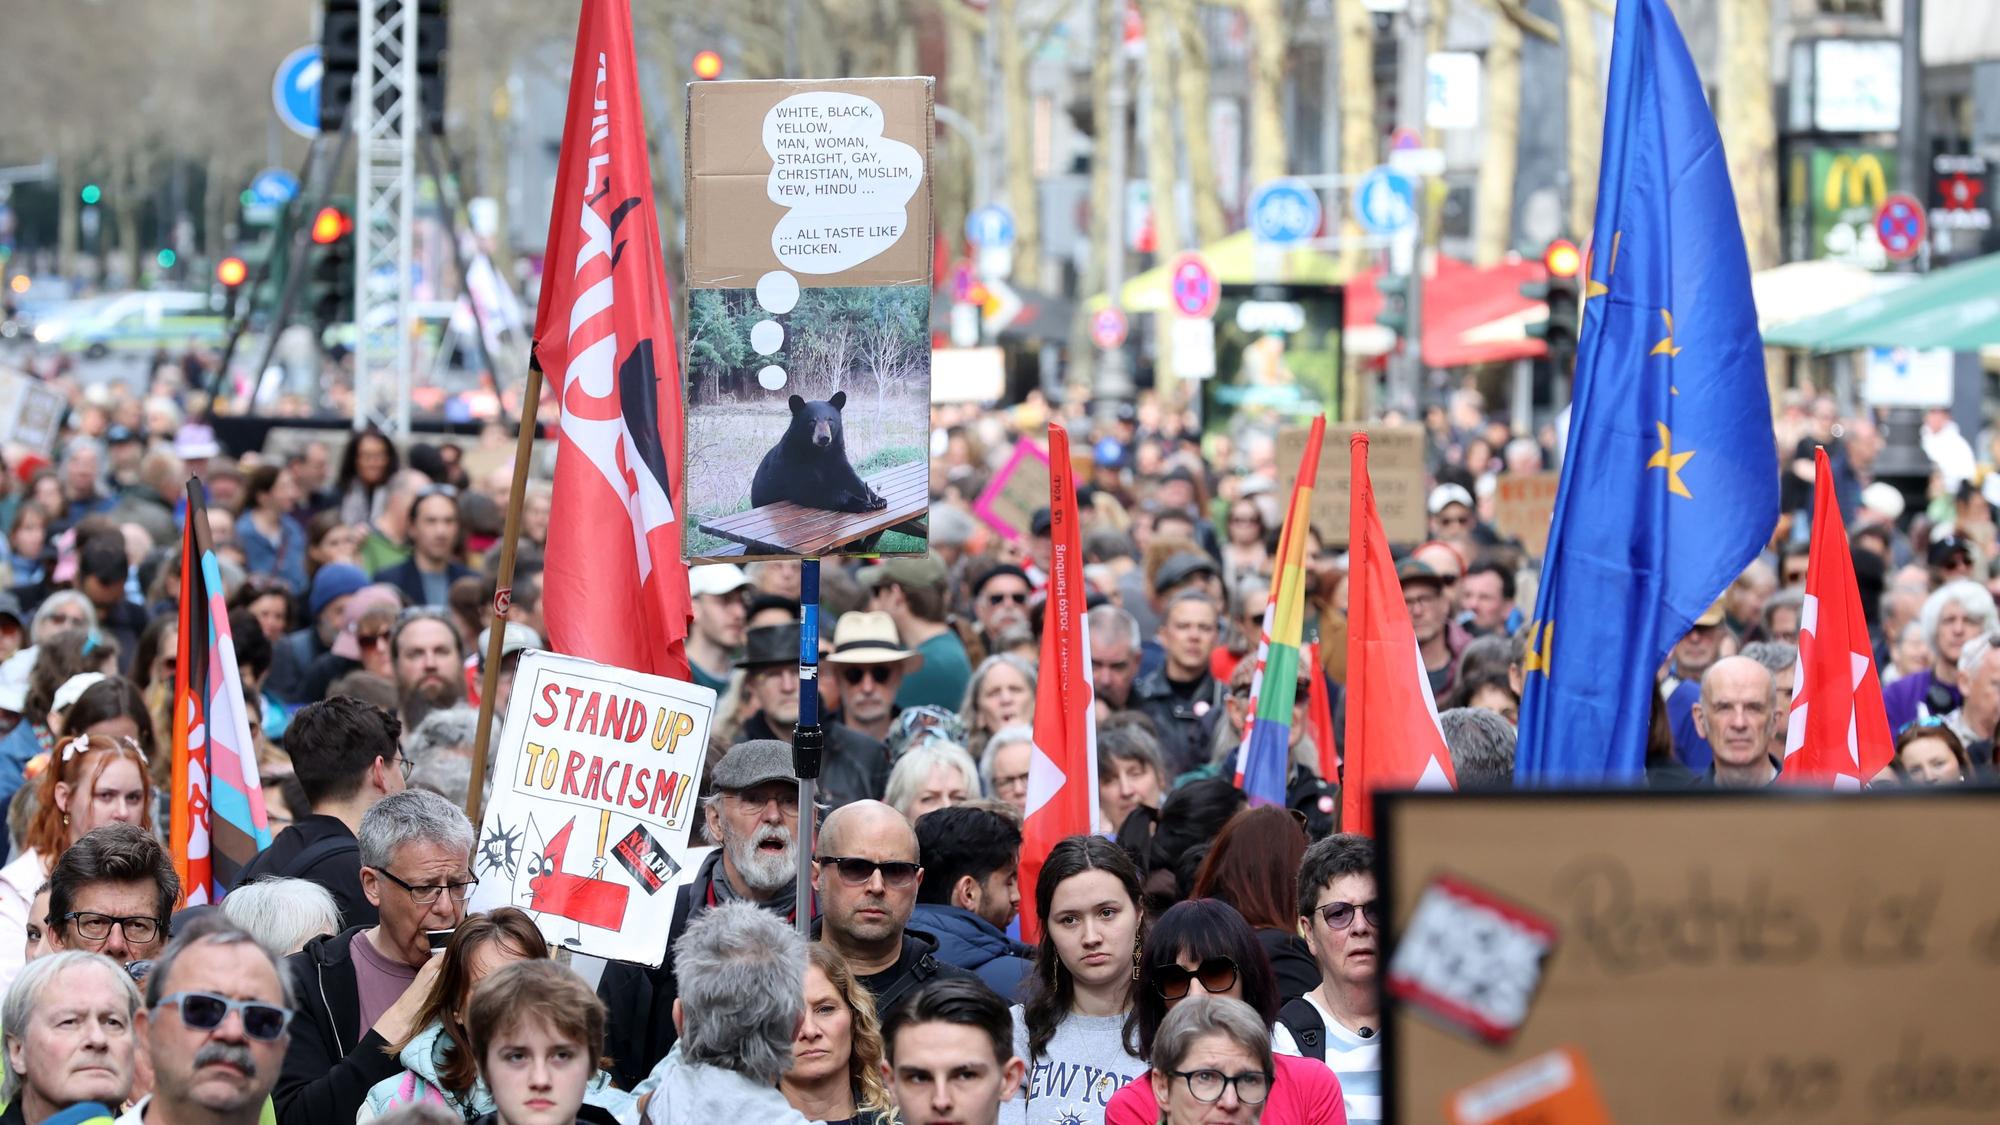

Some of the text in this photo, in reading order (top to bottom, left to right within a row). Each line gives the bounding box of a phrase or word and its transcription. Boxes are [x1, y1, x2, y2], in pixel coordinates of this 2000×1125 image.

[776, 106, 873, 119] WHITE, BLACK,
[776, 122, 832, 134] YELLOW,
[777, 137, 869, 150] MAN, WOMAN,
[777, 152, 881, 165] STRAIGHT, GAY,
[777, 167, 912, 181] CHRISTIAN, MUSLIM,
[777, 185, 810, 197] YEW,
[815, 184, 857, 195] HINDU
[797, 229, 820, 240] ALL
[824, 227, 864, 238] TASTE
[869, 226, 897, 237] LIKE
[779, 244, 842, 256] CHICKEN.
[1055, 543, 1067, 596] Hamburg
[1059, 598, 1070, 631] 20459
[532, 682, 694, 754] STAND UP
[524, 742, 691, 827] TO RACISM!
[1029, 1061, 1080, 1101] EW
